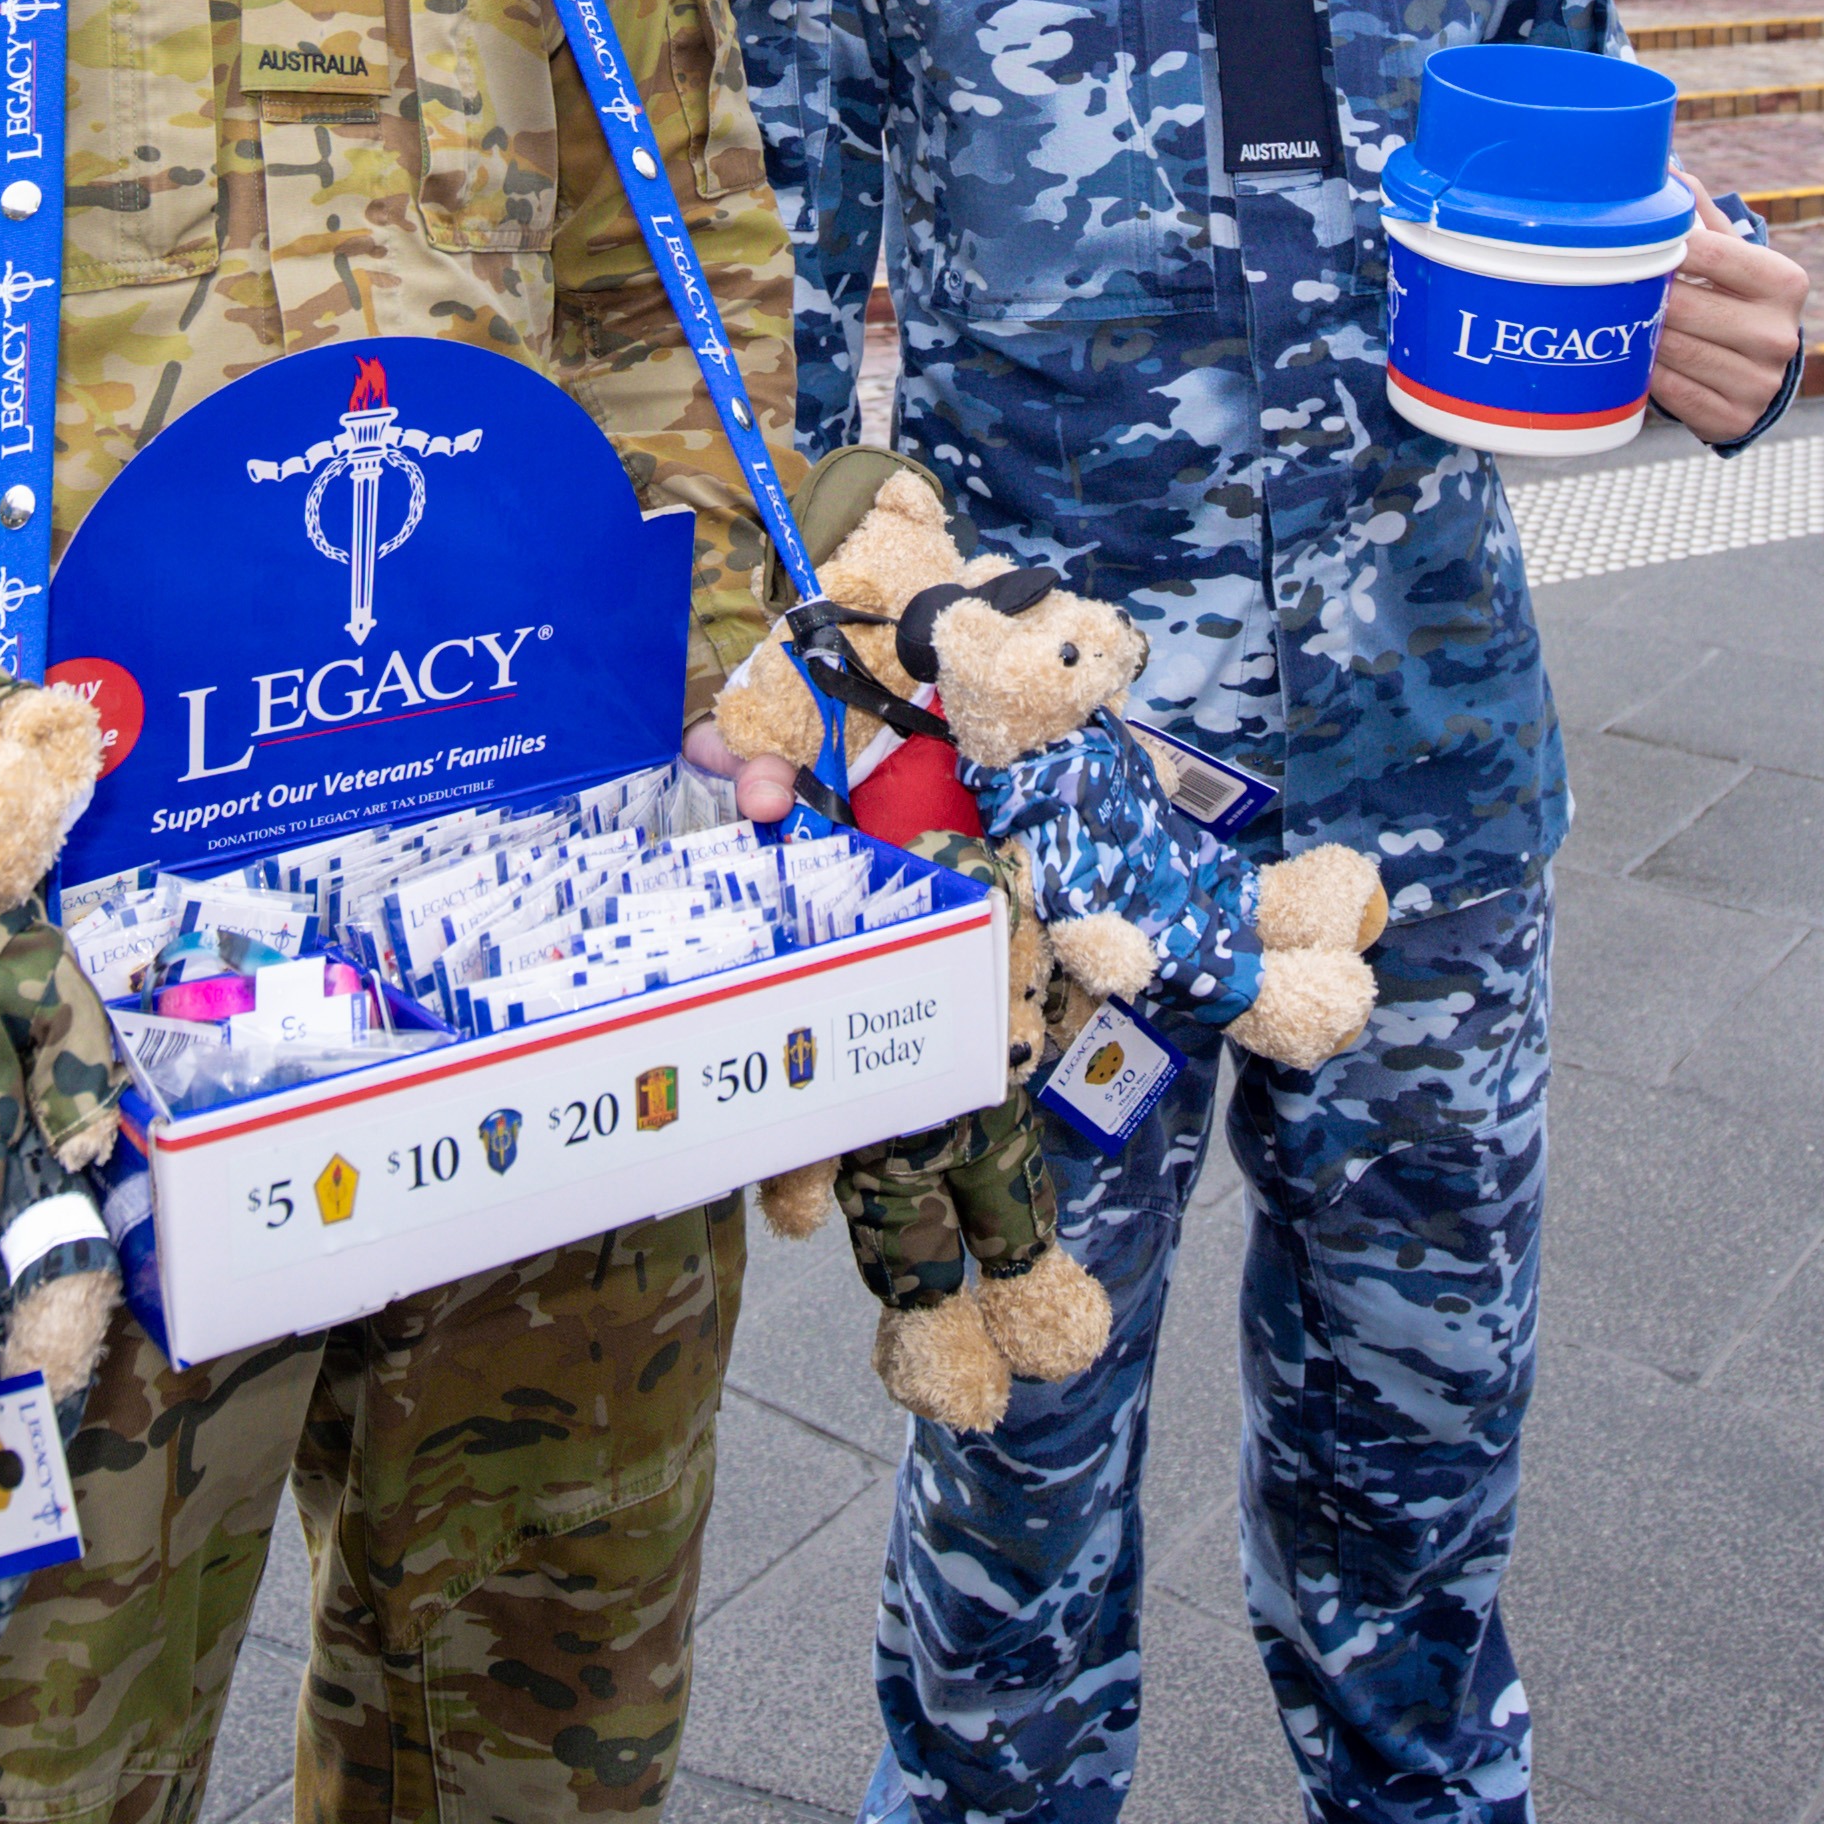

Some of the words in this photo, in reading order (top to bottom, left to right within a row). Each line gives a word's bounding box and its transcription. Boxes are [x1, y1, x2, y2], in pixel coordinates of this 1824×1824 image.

[258, 49, 368, 77] AUSTRALIA
[5, 39, 42, 162] LEGACY
[1239, 139, 1321, 164] AUSTRALIA
[650, 214, 714, 327] LEGACY
[1453, 308, 1642, 364] LEGACY
[0, 321, 34, 460] LEGACY
[751, 461, 812, 582] LEGACY
[150, 790, 262, 834] Support
[267, 780, 317, 808] Our
[446, 731, 547, 772] Families
[1097, 797, 1113, 824] AIR
[207, 822, 286, 851] DONATIONS
[288, 819, 307, 833] TO
[309, 807, 361, 829] LEGACY
[362, 802, 388, 818] ARE
[390, 795, 416, 809] TAX
[418, 779, 496, 805] DEDUCTIBLE
[410, 887, 467, 928] LEGACY
[847, 998, 938, 1041] Donate
[847, 1036, 926, 1077] Today
[1057, 1031, 1095, 1086] LEGACY
[247, 1178, 294, 1229] $5
[387, 1135, 460, 1190] $10
[547, 1092, 619, 1148] $20
[702, 1050, 768, 1103] $50
[17, 1402, 52, 1488] LEGACY
